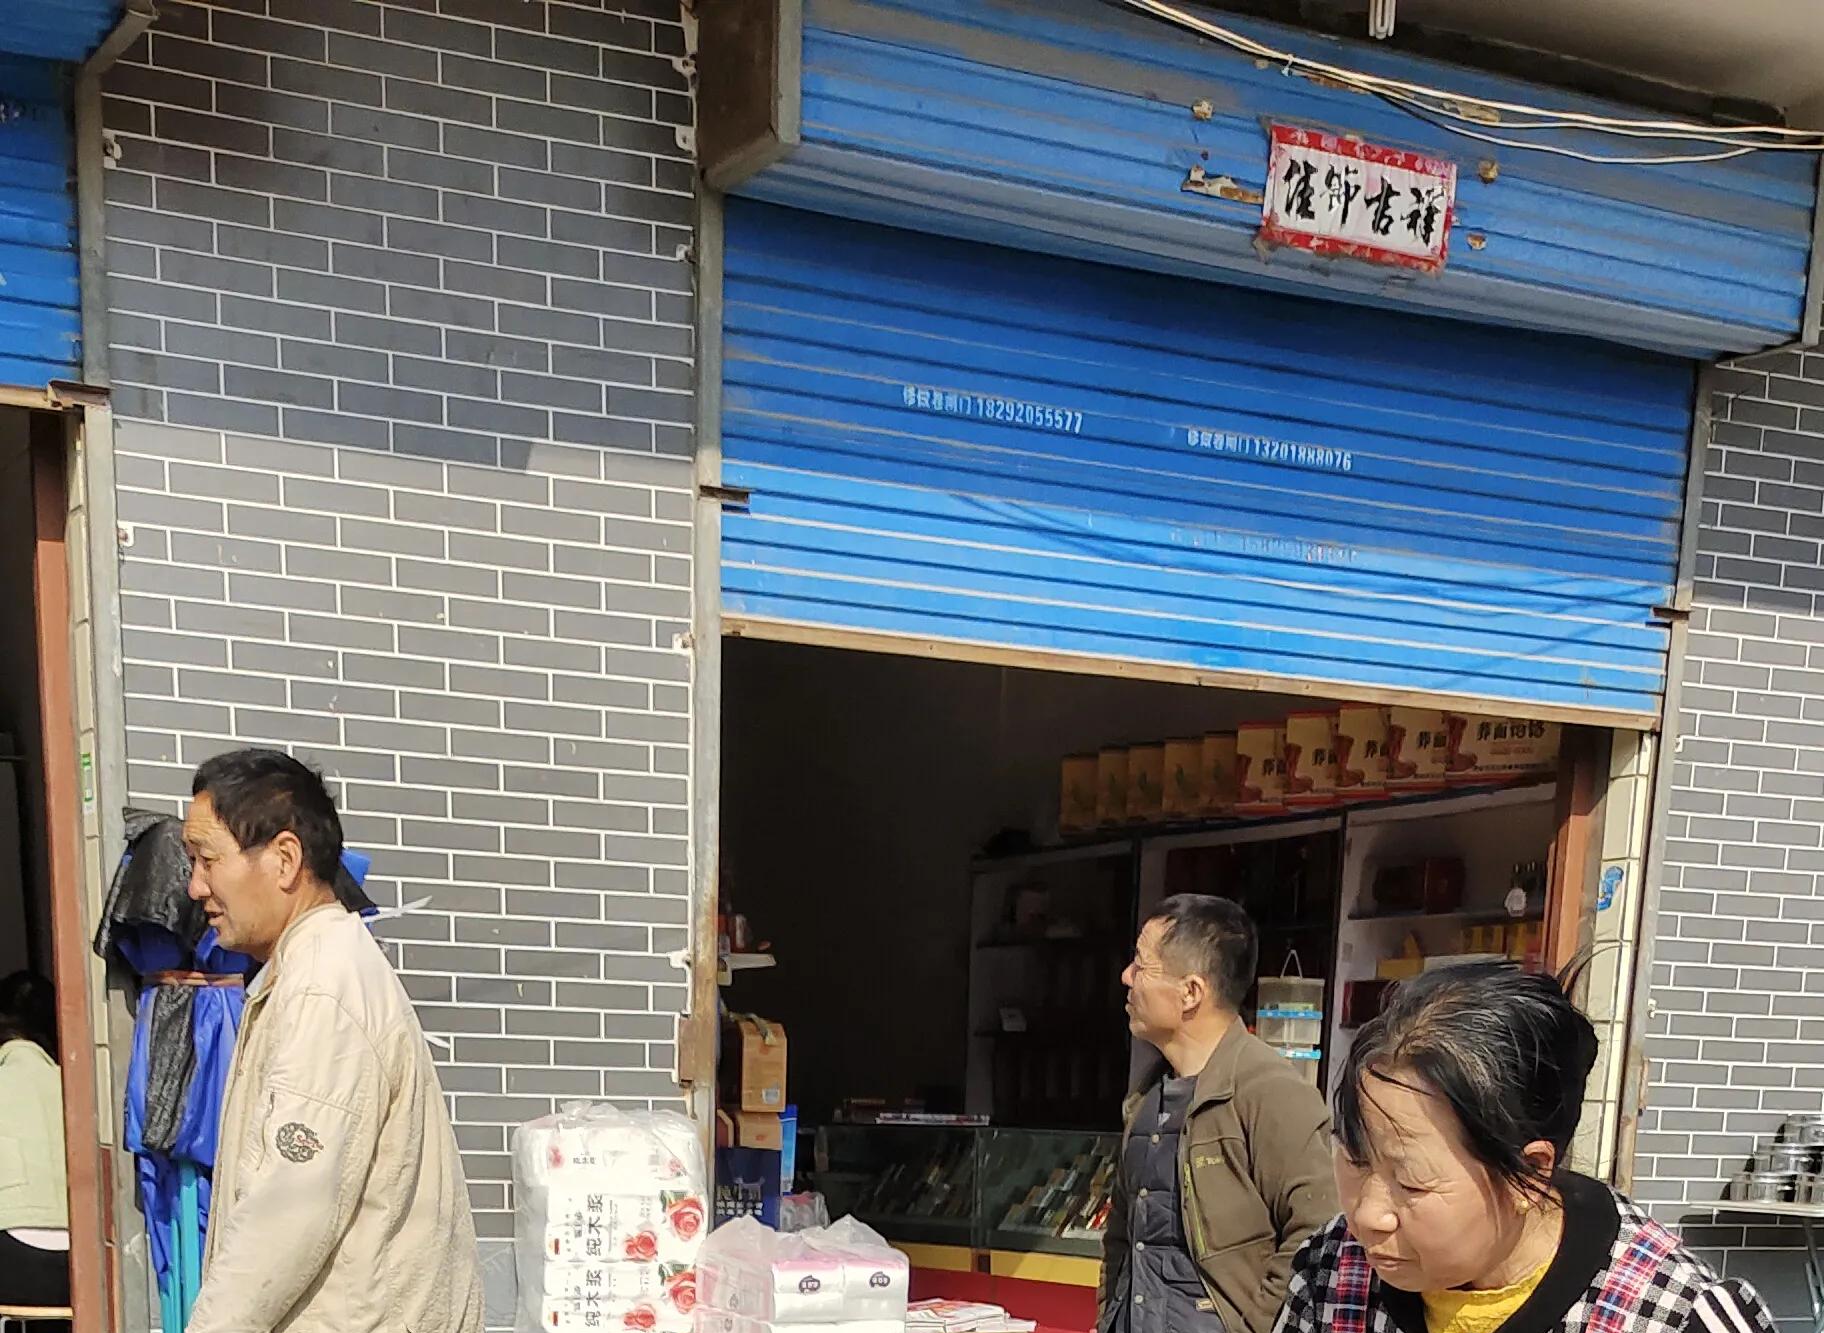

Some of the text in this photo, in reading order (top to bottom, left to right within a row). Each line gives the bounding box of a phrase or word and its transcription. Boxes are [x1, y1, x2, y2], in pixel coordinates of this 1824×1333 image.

[976, 396, 1083, 434] 18292055577
[585, 1193, 603, 1257] 纯木浆
[584, 1269, 603, 1328] 纯木浆
